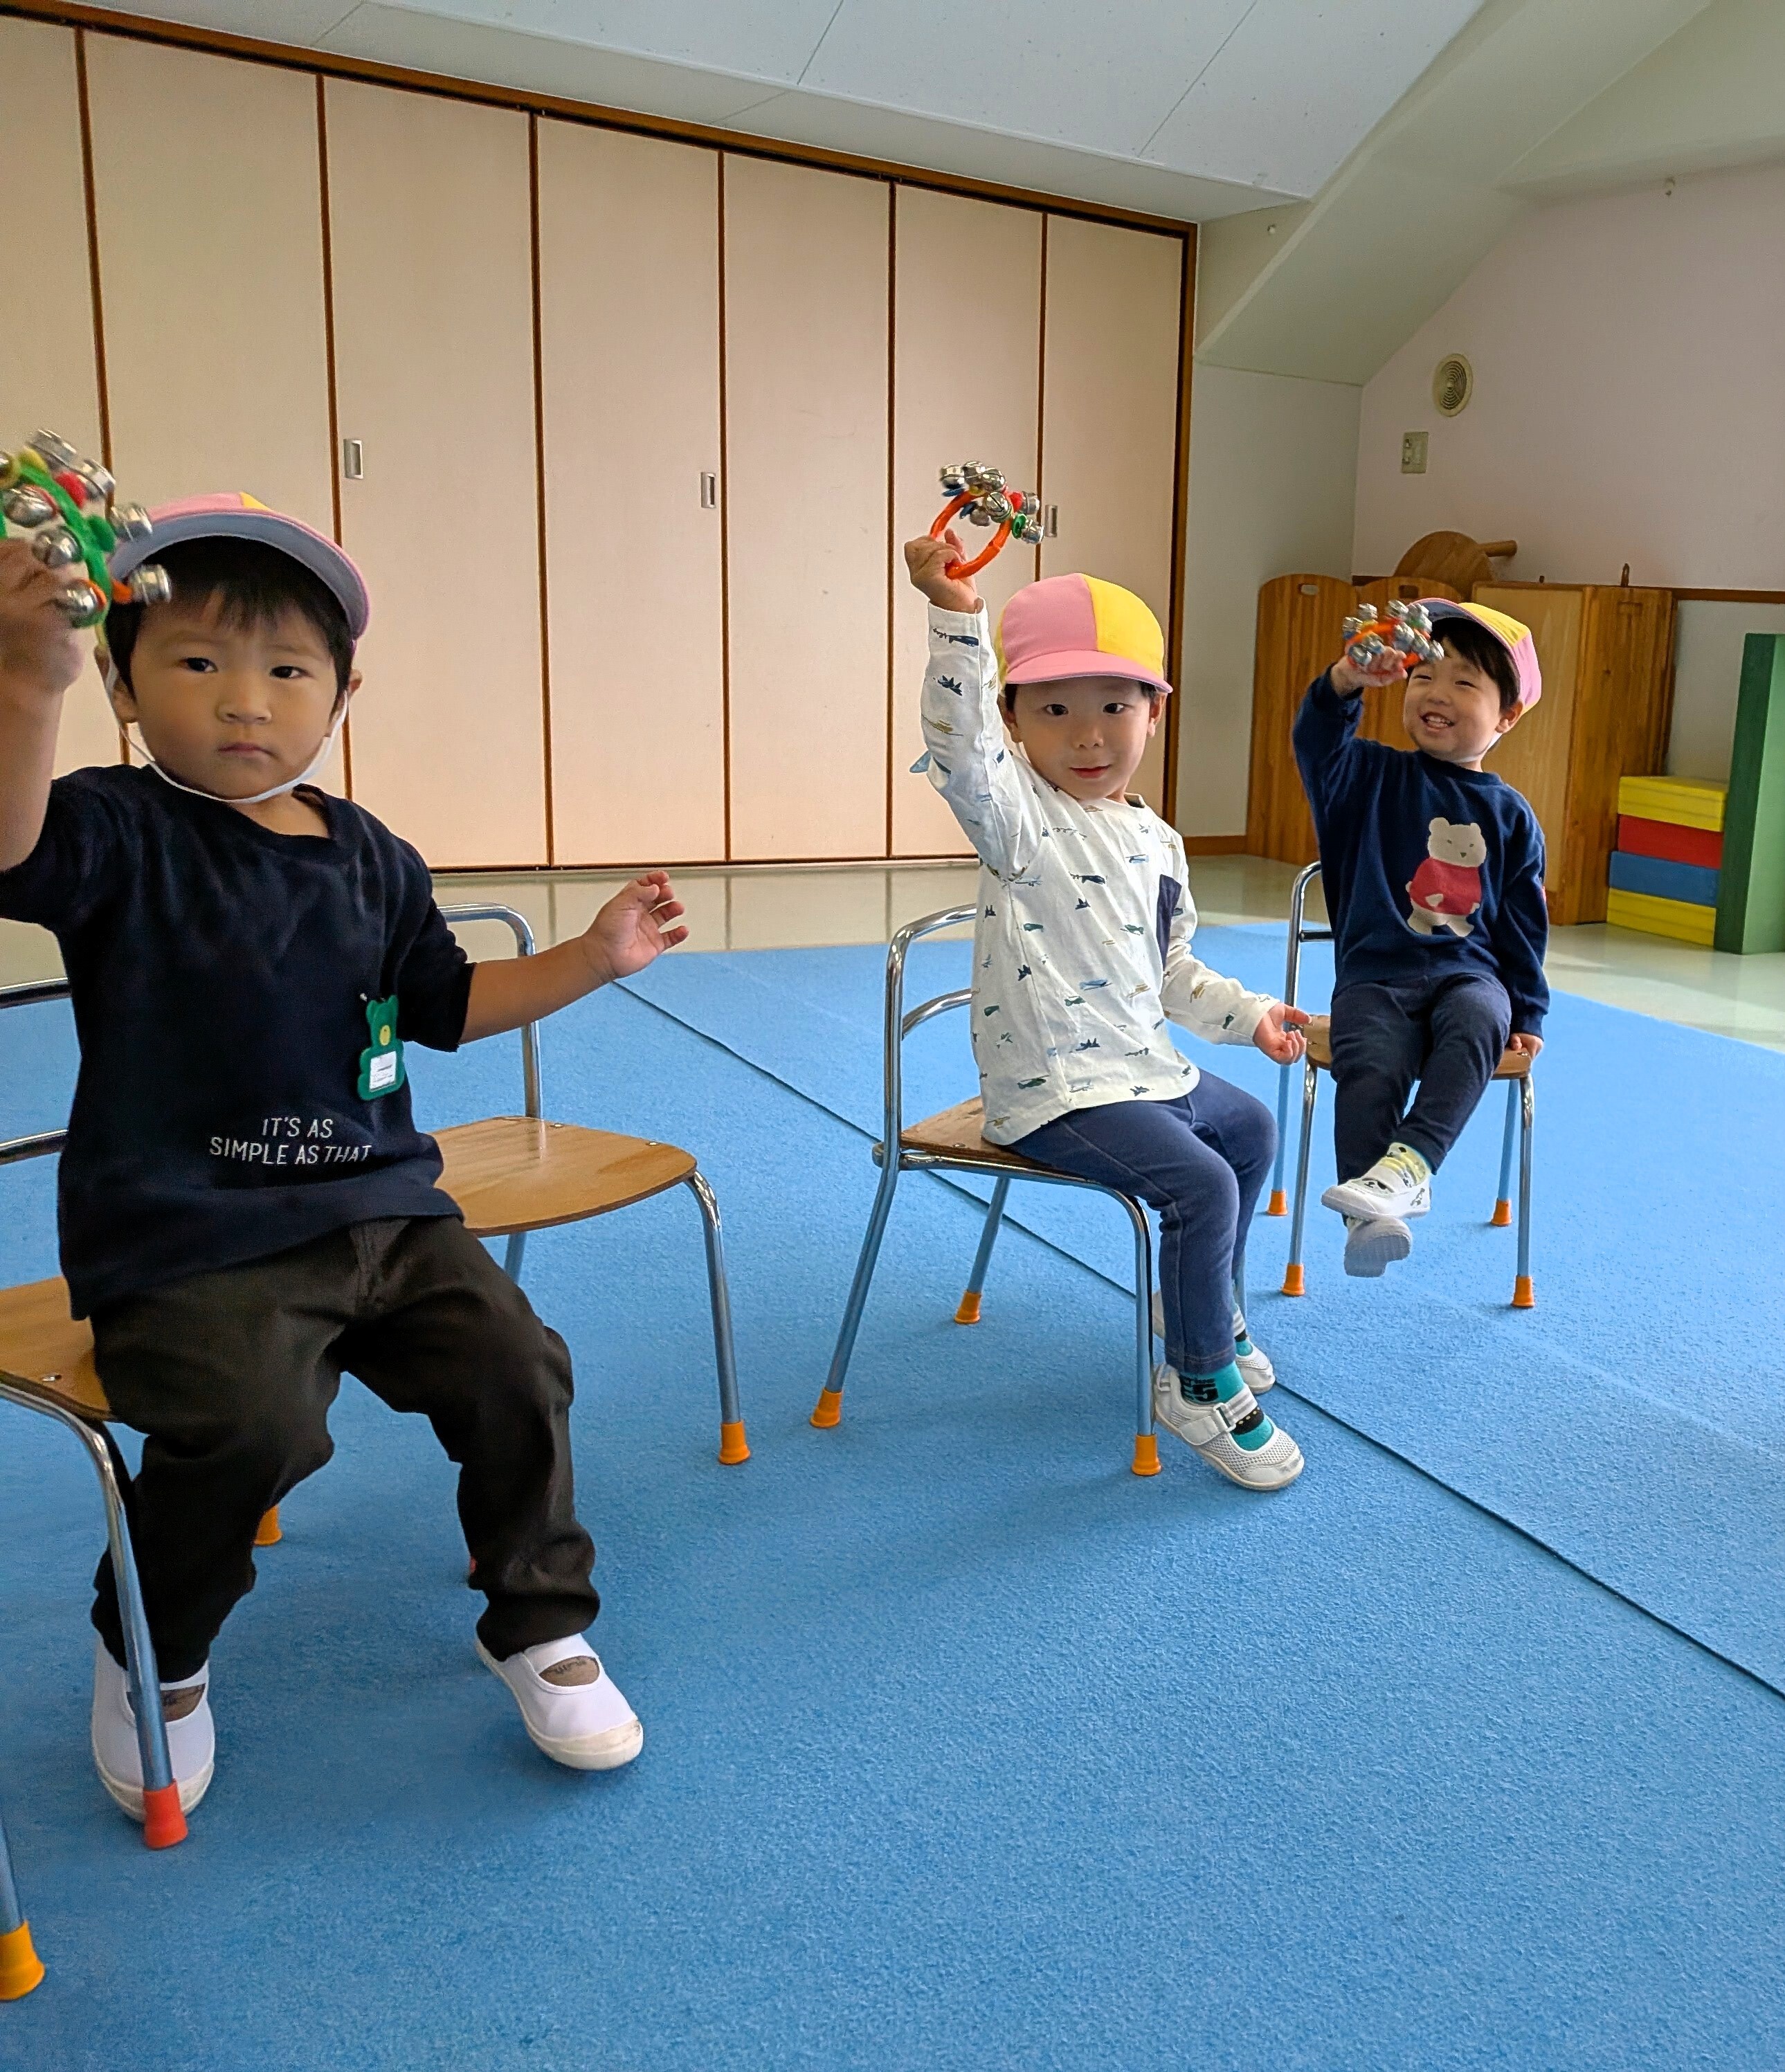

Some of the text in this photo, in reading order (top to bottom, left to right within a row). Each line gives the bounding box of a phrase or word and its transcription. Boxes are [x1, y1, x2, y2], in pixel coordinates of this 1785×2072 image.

[261, 1116, 334, 1138] IT'S AS
[209, 1136, 372, 1165] SIMPLE AS THAT
